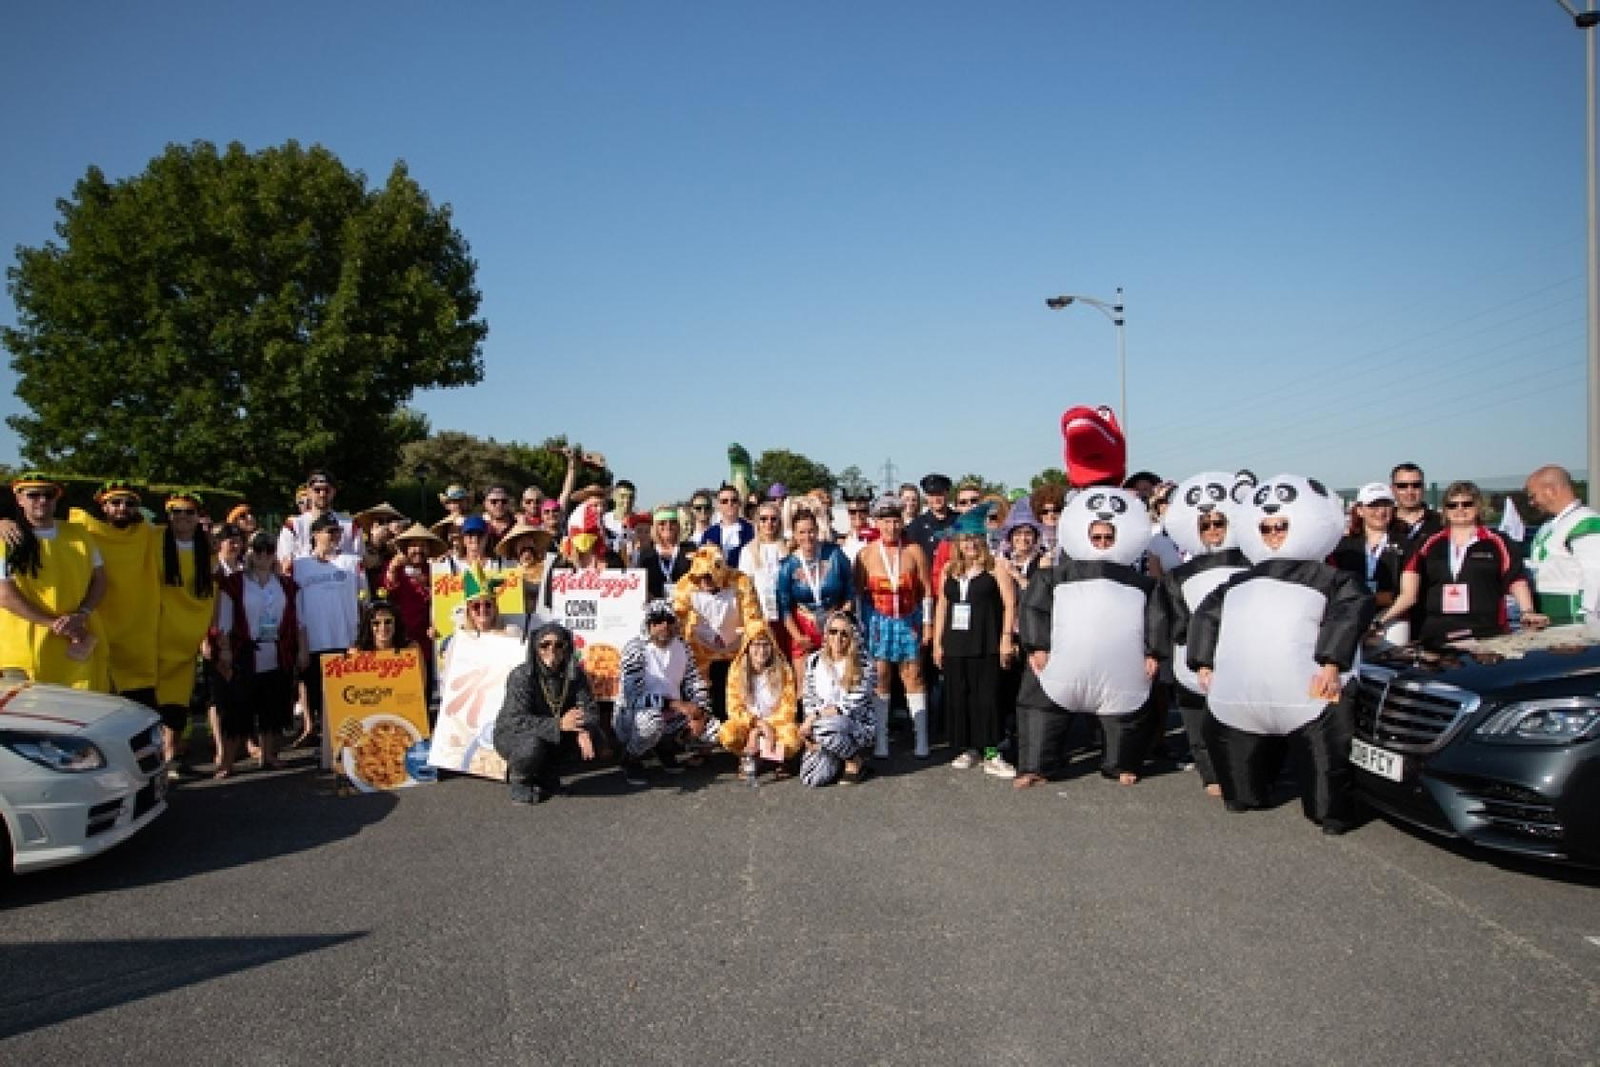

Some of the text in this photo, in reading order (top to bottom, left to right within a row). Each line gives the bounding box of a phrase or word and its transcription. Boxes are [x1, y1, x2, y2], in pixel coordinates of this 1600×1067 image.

[551, 568, 641, 598] Kellogg's
[565, 599, 598, 616] CORN
[324, 652, 417, 679] Kellogg's
